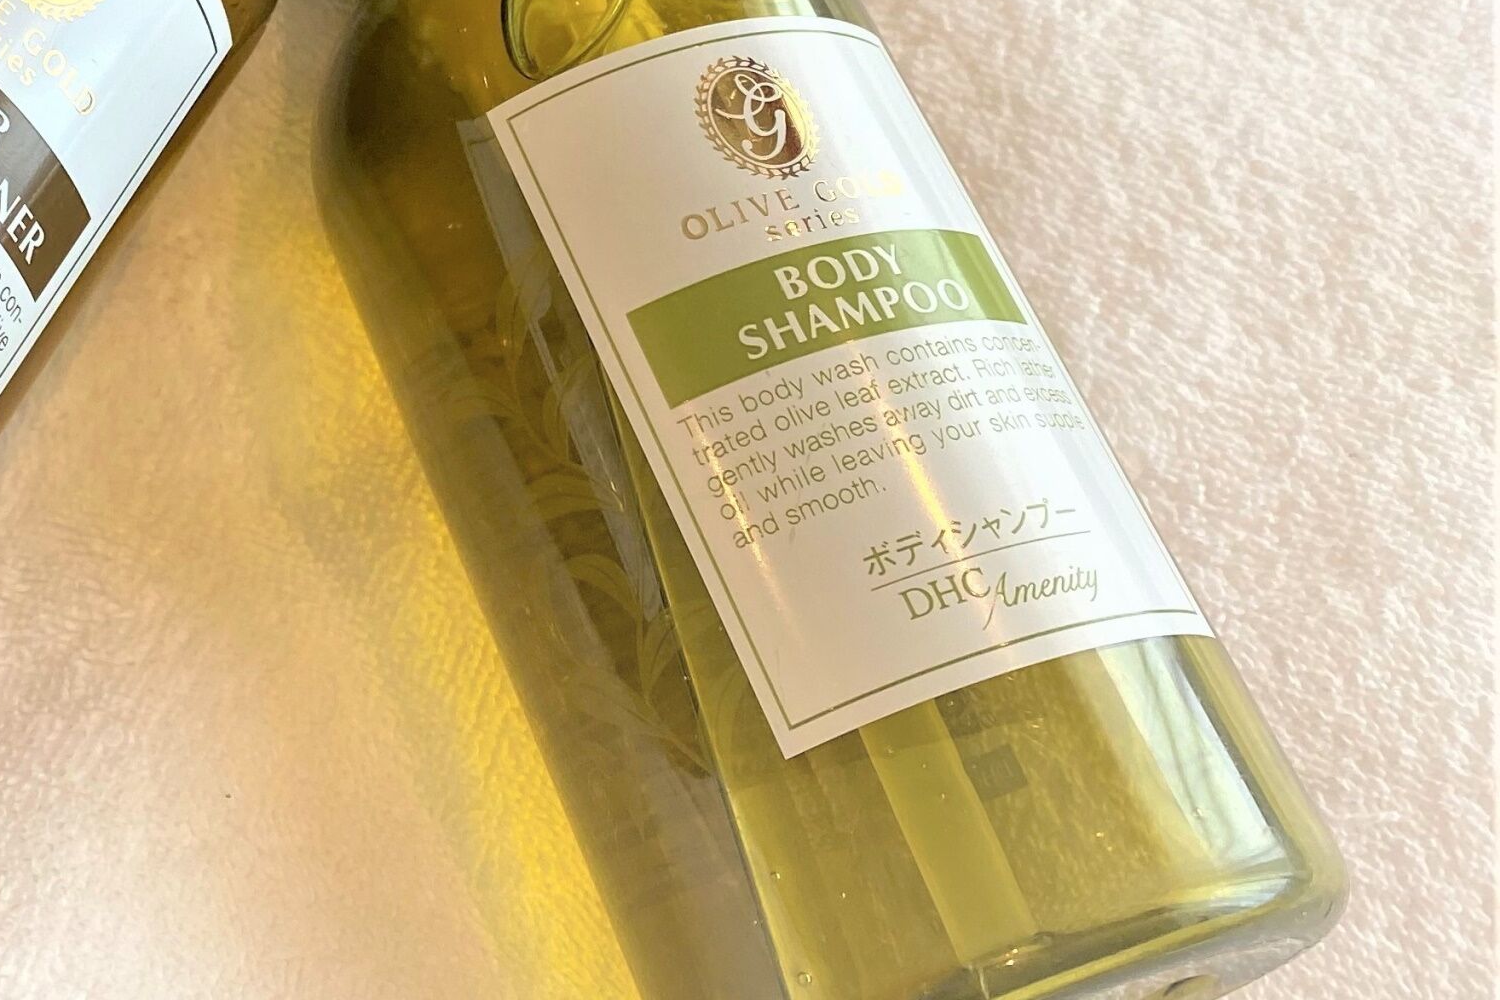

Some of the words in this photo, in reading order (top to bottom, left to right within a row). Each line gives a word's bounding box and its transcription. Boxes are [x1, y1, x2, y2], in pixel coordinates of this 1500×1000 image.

[21, 27, 96, 116] GOLD
[680, 188, 800, 240] OLIVE
[764, 206, 860, 241] series
[0, 286, 22, 324] con-
[773, 243, 901, 300] BODY
[737, 277, 970, 360] SHAMPOO
[676, 405, 733, 438] This
[738, 376, 803, 413] body
[811, 353, 879, 386] wash
[886, 335, 977, 365] contains
[691, 419, 767, 465] trated
[774, 399, 830, 431] olive
[834, 378, 880, 409] leaf
[887, 363, 970, 394] extract.
[972, 357, 1013, 378] Rich
[706, 450, 777, 498] gently
[783, 415, 877, 459] washes
[882, 398, 942, 427] away
[947, 387, 980, 411] dirt
[984, 384, 1021, 406] and
[1025, 384, 1071, 404] excess
[720, 491, 750, 520] oil
[756, 465, 825, 503] while
[831, 432, 927, 473] leaving
[931, 417, 981, 448] your
[988, 410, 1033, 433] skin
[732, 511, 779, 549] and
[785, 476, 887, 525] smooth.
[862, 497, 1075, 577] ボディシャンプー
[898, 567, 990, 620] DHC
[982, 565, 1097, 631] Amenity
